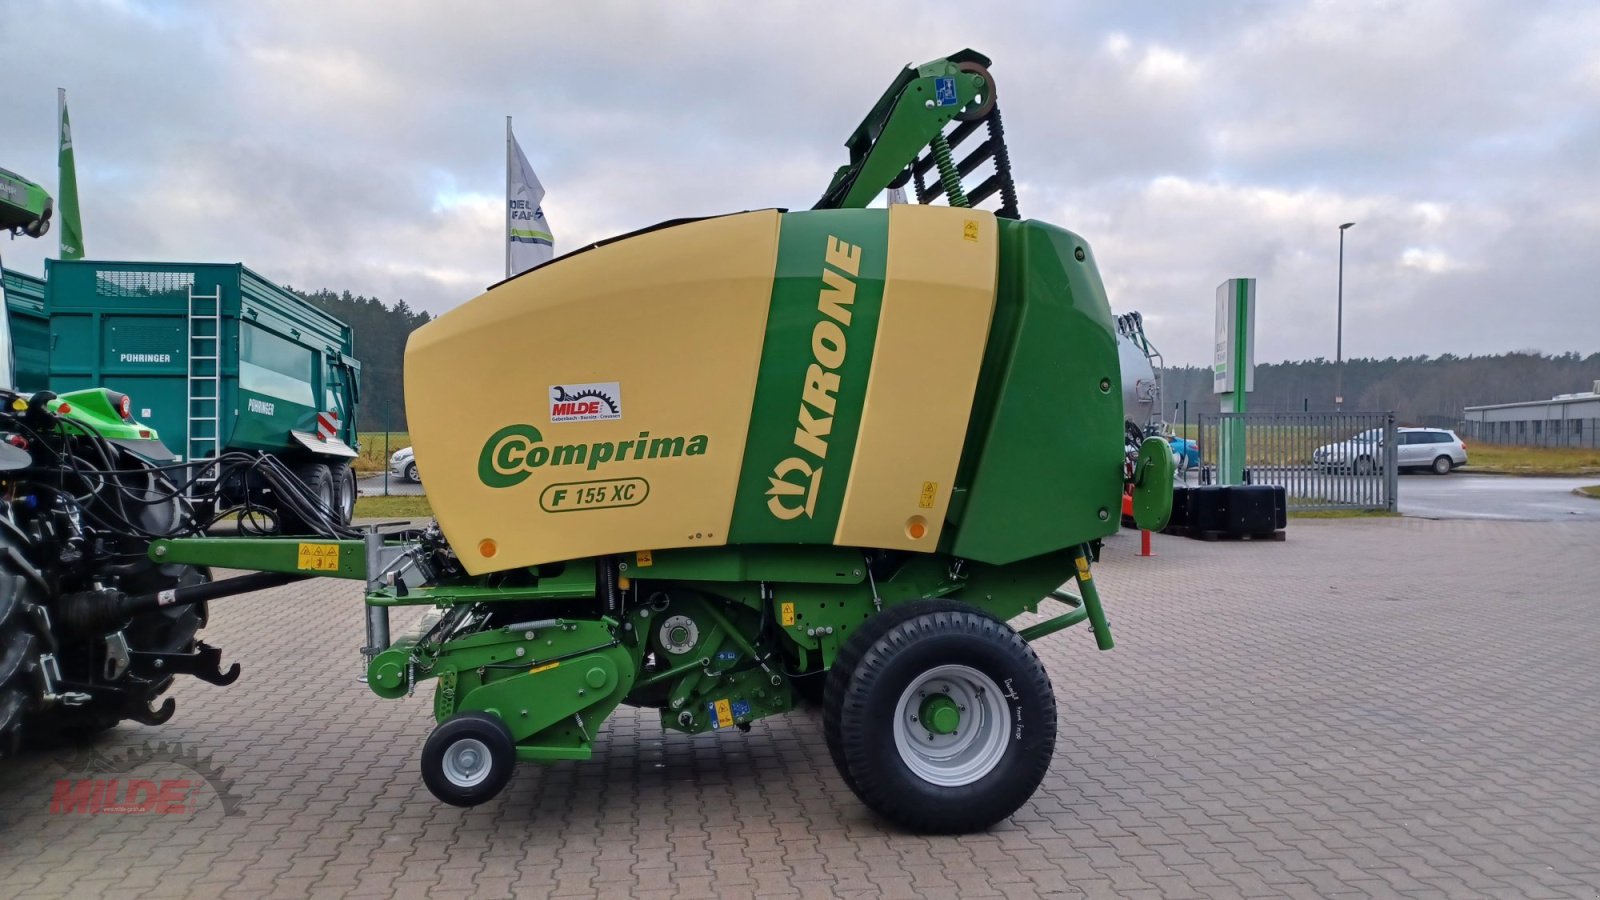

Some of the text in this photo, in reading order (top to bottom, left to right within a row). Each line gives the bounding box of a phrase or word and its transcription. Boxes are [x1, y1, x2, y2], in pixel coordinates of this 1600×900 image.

[793, 234, 862, 459] KRONE
[552, 401, 600, 416] MILDE
[478, 423, 709, 489] Comprima
[552, 484, 636, 507] F 155 XC
